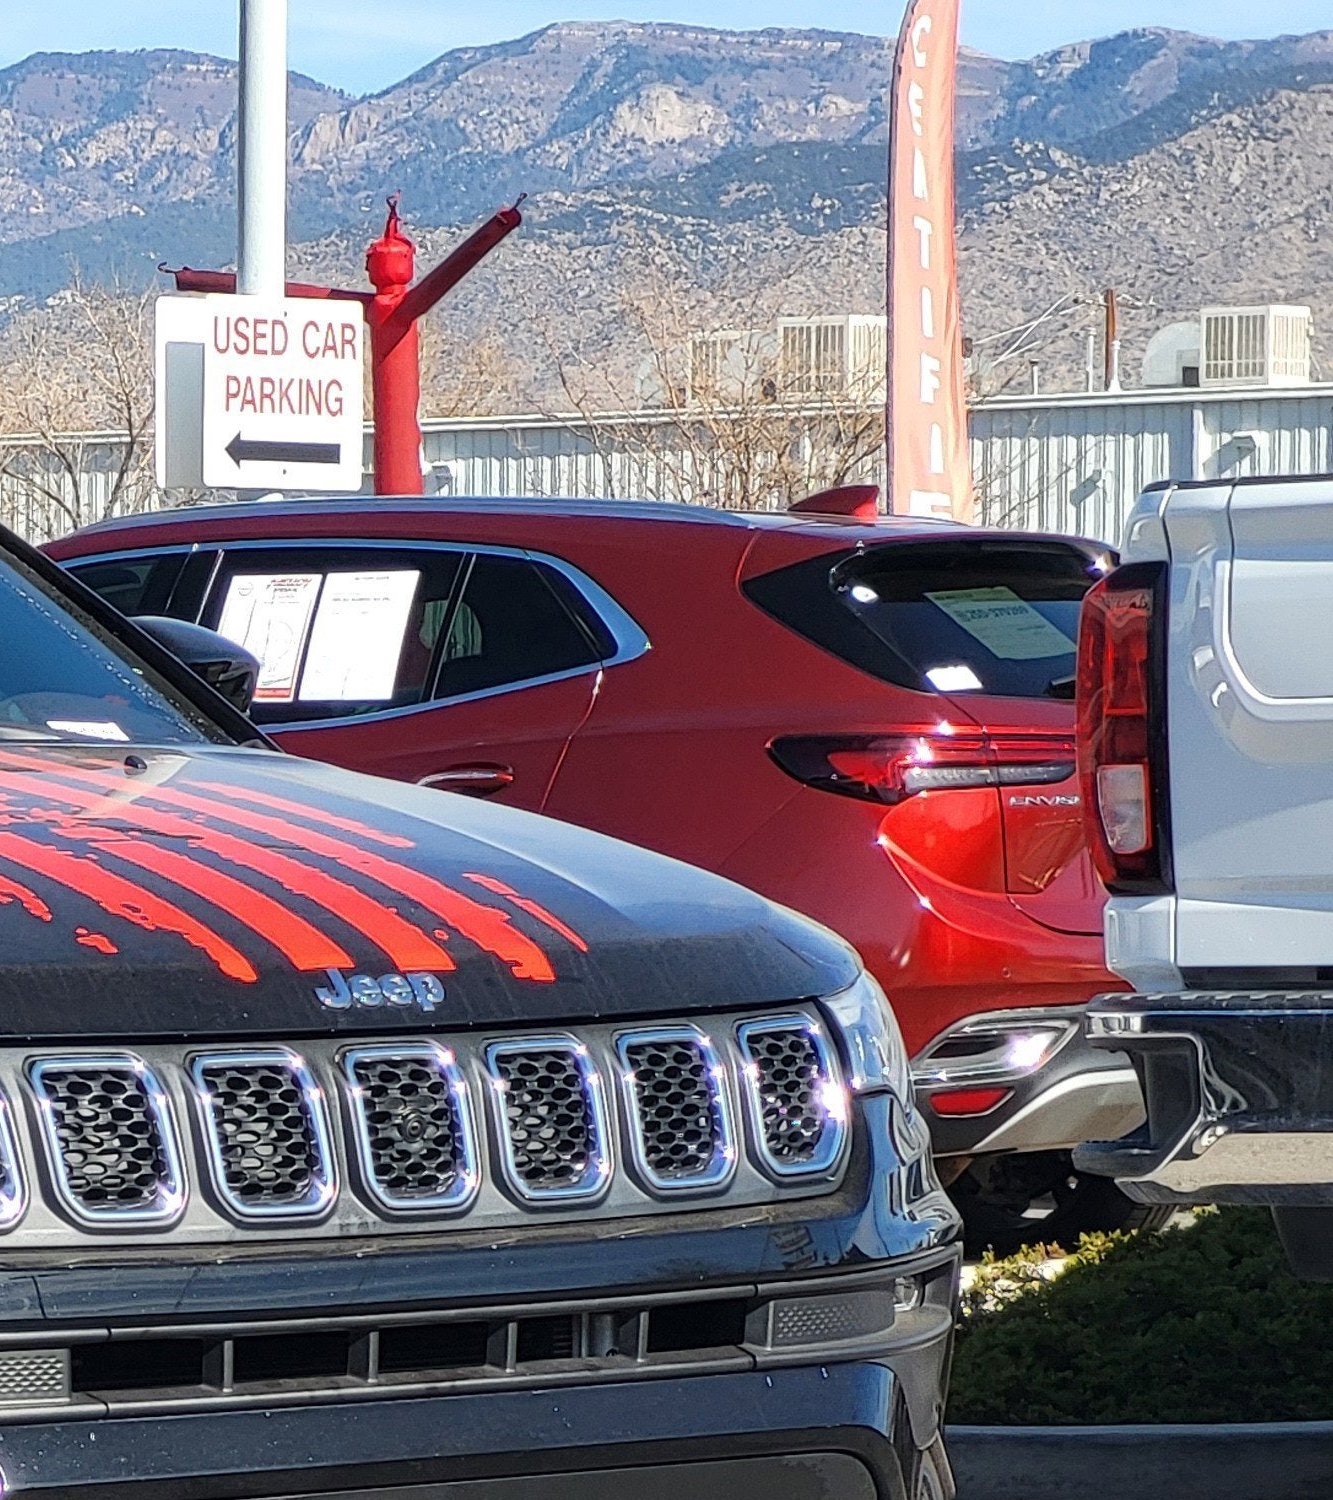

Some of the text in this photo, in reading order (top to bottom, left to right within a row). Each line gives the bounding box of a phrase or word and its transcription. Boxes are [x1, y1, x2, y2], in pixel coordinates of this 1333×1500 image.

[213, 315, 357, 360] USED CAR
[225, 374, 344, 417] PARKING
[1009, 795, 1081, 807] ENVISI
[313, 967, 446, 1013] Jeep
